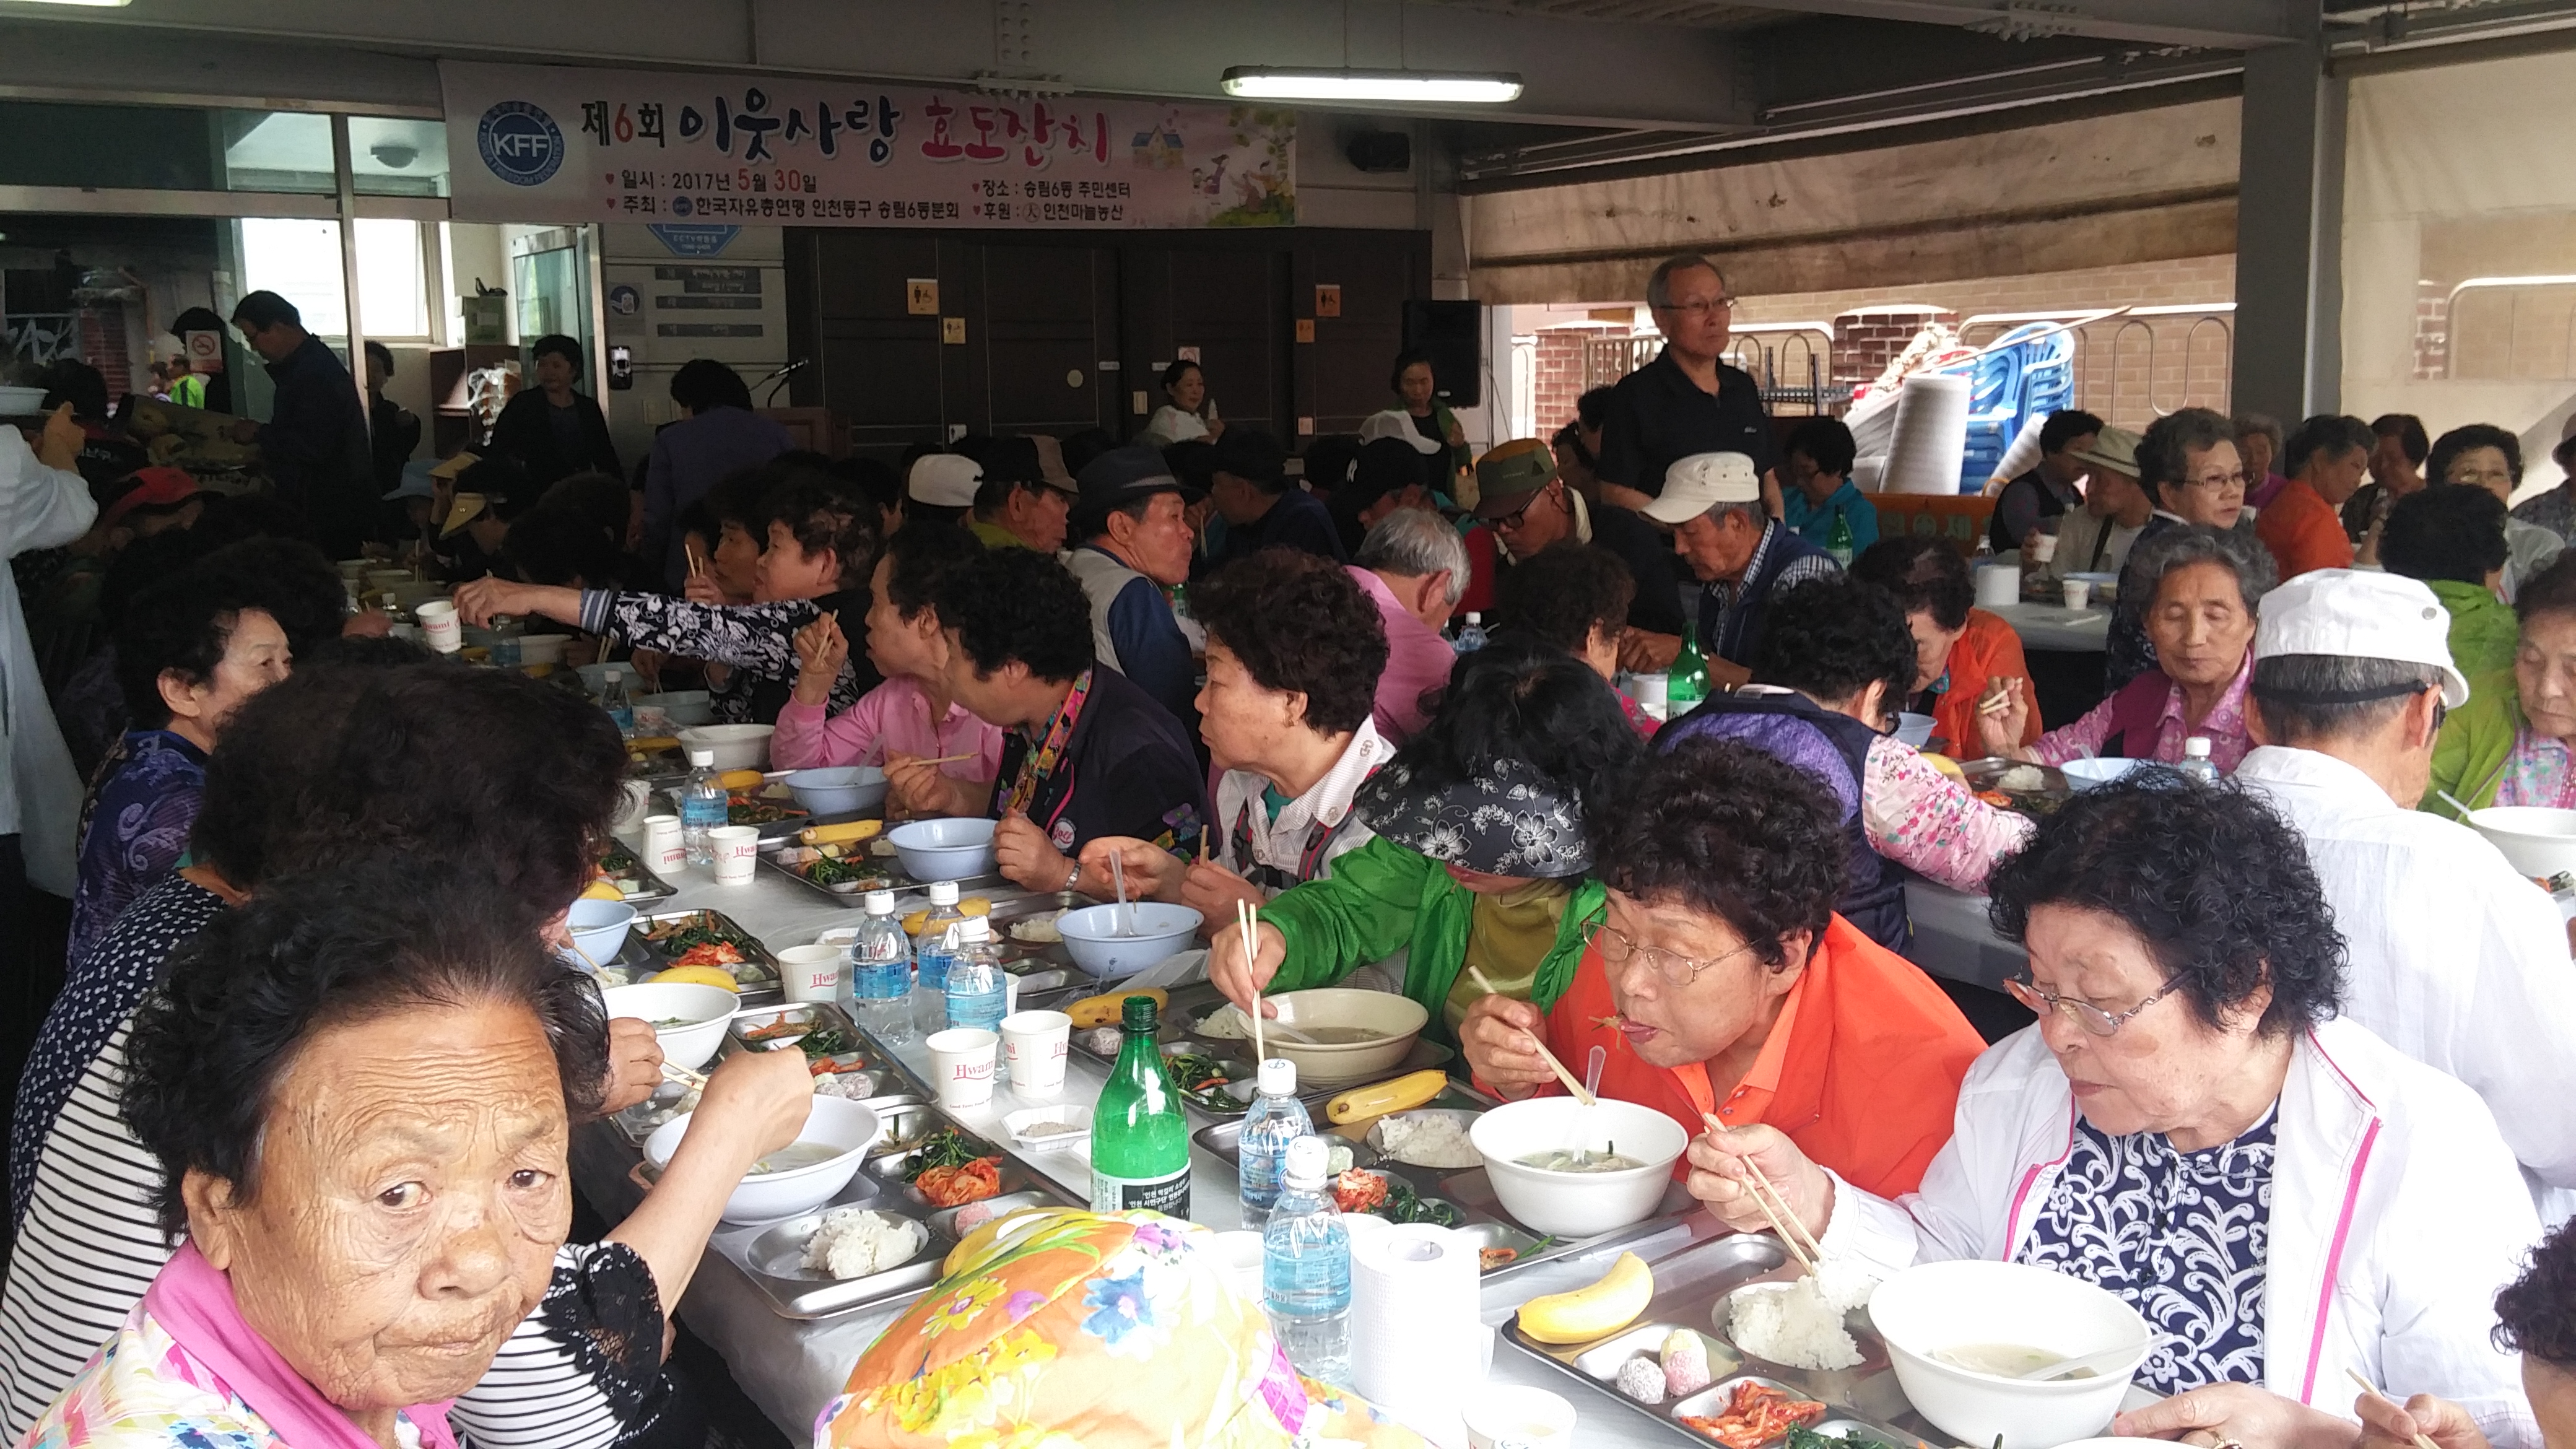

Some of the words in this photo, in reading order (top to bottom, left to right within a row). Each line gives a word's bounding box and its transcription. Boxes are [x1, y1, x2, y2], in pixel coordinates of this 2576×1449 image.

[581, 100, 665, 148] 제6회
[680, 87, 900, 163] 이웃사랑
[922, 95, 1107, 167] 효도잔치
[492, 133, 549, 157] KFF
[622, 169, 655, 190] 일시
[672, 172, 731, 191] 2017년
[737, 167, 767, 192] 5월
[773, 169, 817, 193] 30일
[982, 179, 1010, 198] 장소
[1024, 180, 1073, 198] 송림6동
[1078, 181, 1131, 199] 주민센터
[623, 195, 656, 215] 주최
[696, 197, 806, 218] 한국자유총연맹
[812, 199, 872, 219] 인천동구
[877, 200, 959, 220] 송림6동분회
[983, 202, 1011, 220] 후원
[1043, 202, 1124, 221] 인천마늘농산
